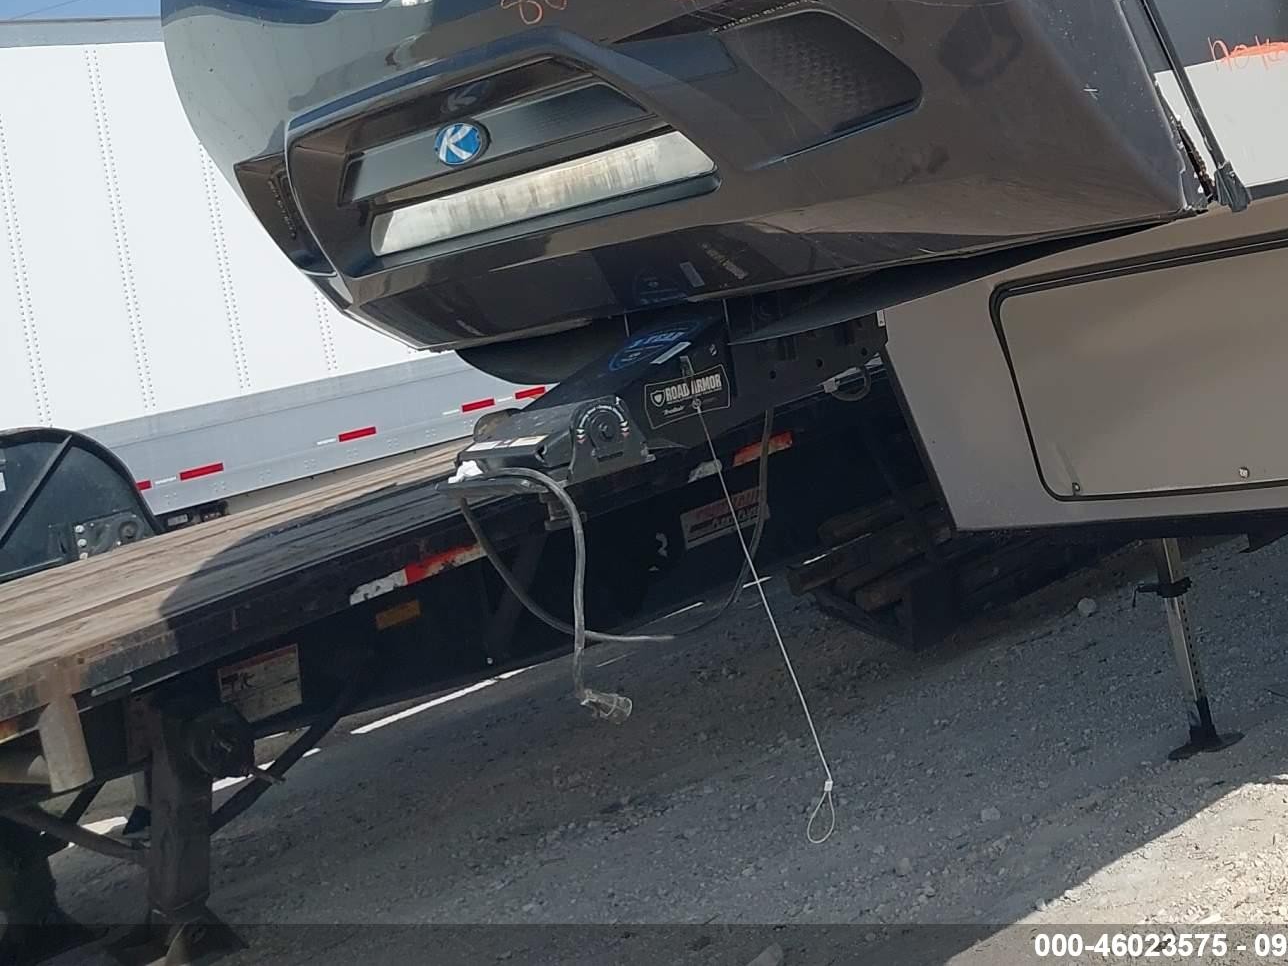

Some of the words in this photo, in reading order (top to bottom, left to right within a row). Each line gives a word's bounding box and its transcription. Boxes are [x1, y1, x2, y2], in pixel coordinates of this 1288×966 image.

[440, 123, 477, 163] K
[664, 382, 691, 402] ROAD
[691, 373, 722, 396] ARMOR
